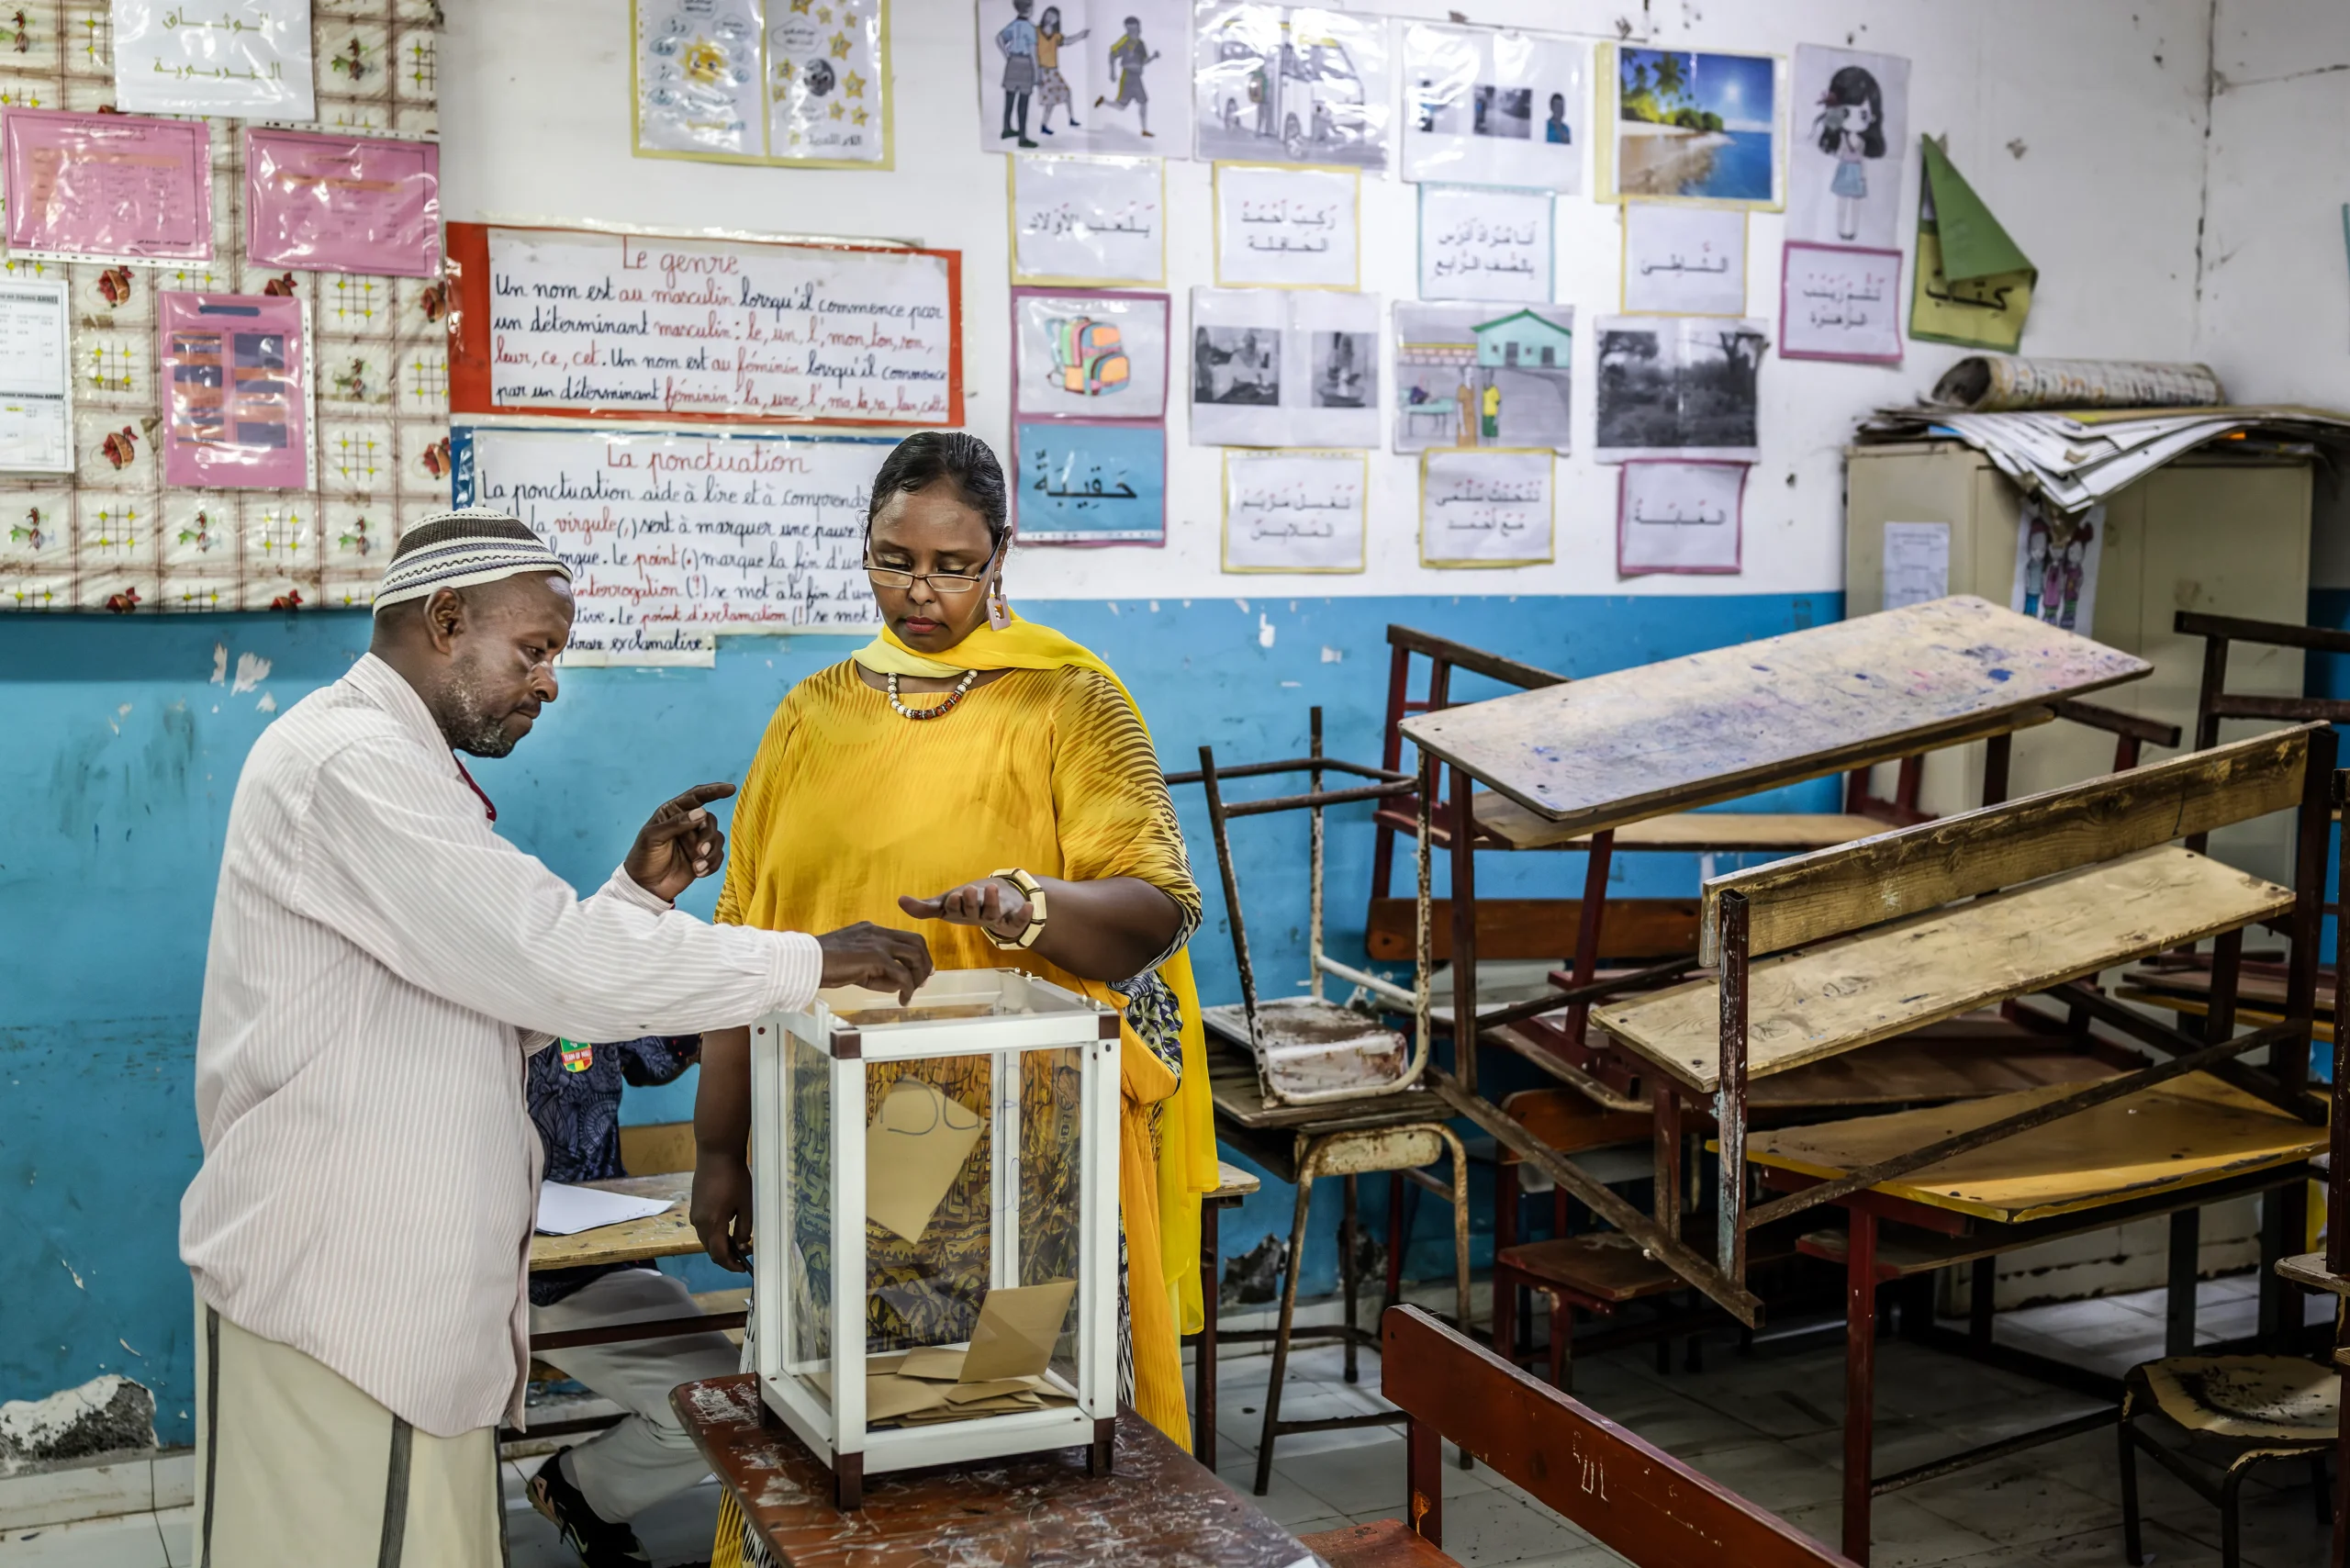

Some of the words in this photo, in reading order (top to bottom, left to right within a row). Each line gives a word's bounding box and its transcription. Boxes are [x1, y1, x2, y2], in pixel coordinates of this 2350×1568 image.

[622, 234, 648, 270] Le
[659, 252, 740, 289] genre
[493, 319, 523, 331] un
[529, 305, 651, 336] déterminant
[495, 273, 528, 297] Un
[532, 282, 584, 301] nom
[585, 276, 616, 302] est
[619, 289, 648, 304] au
[650, 277, 734, 308] masculin
[738, 275, 815, 322] lorsqu'il
[818, 297, 906, 319] commence
[906, 307, 945, 330] par
[495, 383, 528, 406] par
[531, 385, 555, 400] un
[560, 375, 660, 402] déterminant
[610, 347, 638, 366] Un
[641, 355, 681, 369] nom
[684, 346, 709, 371] est
[711, 357, 733, 372] au
[734, 345, 800, 393] féminin
[800, 349, 877, 390] lorsqu'il
[607, 442, 639, 469] La
[647, 440, 812, 485] ponctuation
[482, 468, 507, 500] La
[510, 469, 634, 517] ponctuation
[640, 478, 682, 503] aide
[683, 482, 700, 504] à
[704, 474, 738, 505] lire
[742, 479, 758, 506] et
[761, 483, 778, 506] à
[554, 505, 618, 546] virgule
[639, 510, 676, 533] sert
[678, 515, 692, 533] à
[695, 519, 774, 549] marquer
[778, 524, 811, 538] une
[613, 542, 630, 566] Le
[634, 543, 679, 580] point
[700, 552, 764, 580] marque
[767, 540, 789, 570] la
[793, 540, 821, 585] fin
[734, 575, 775, 600] met
[618, 607, 634, 625] Le
[640, 603, 681, 632] point
[686, 603, 788, 623] d'exclamation
